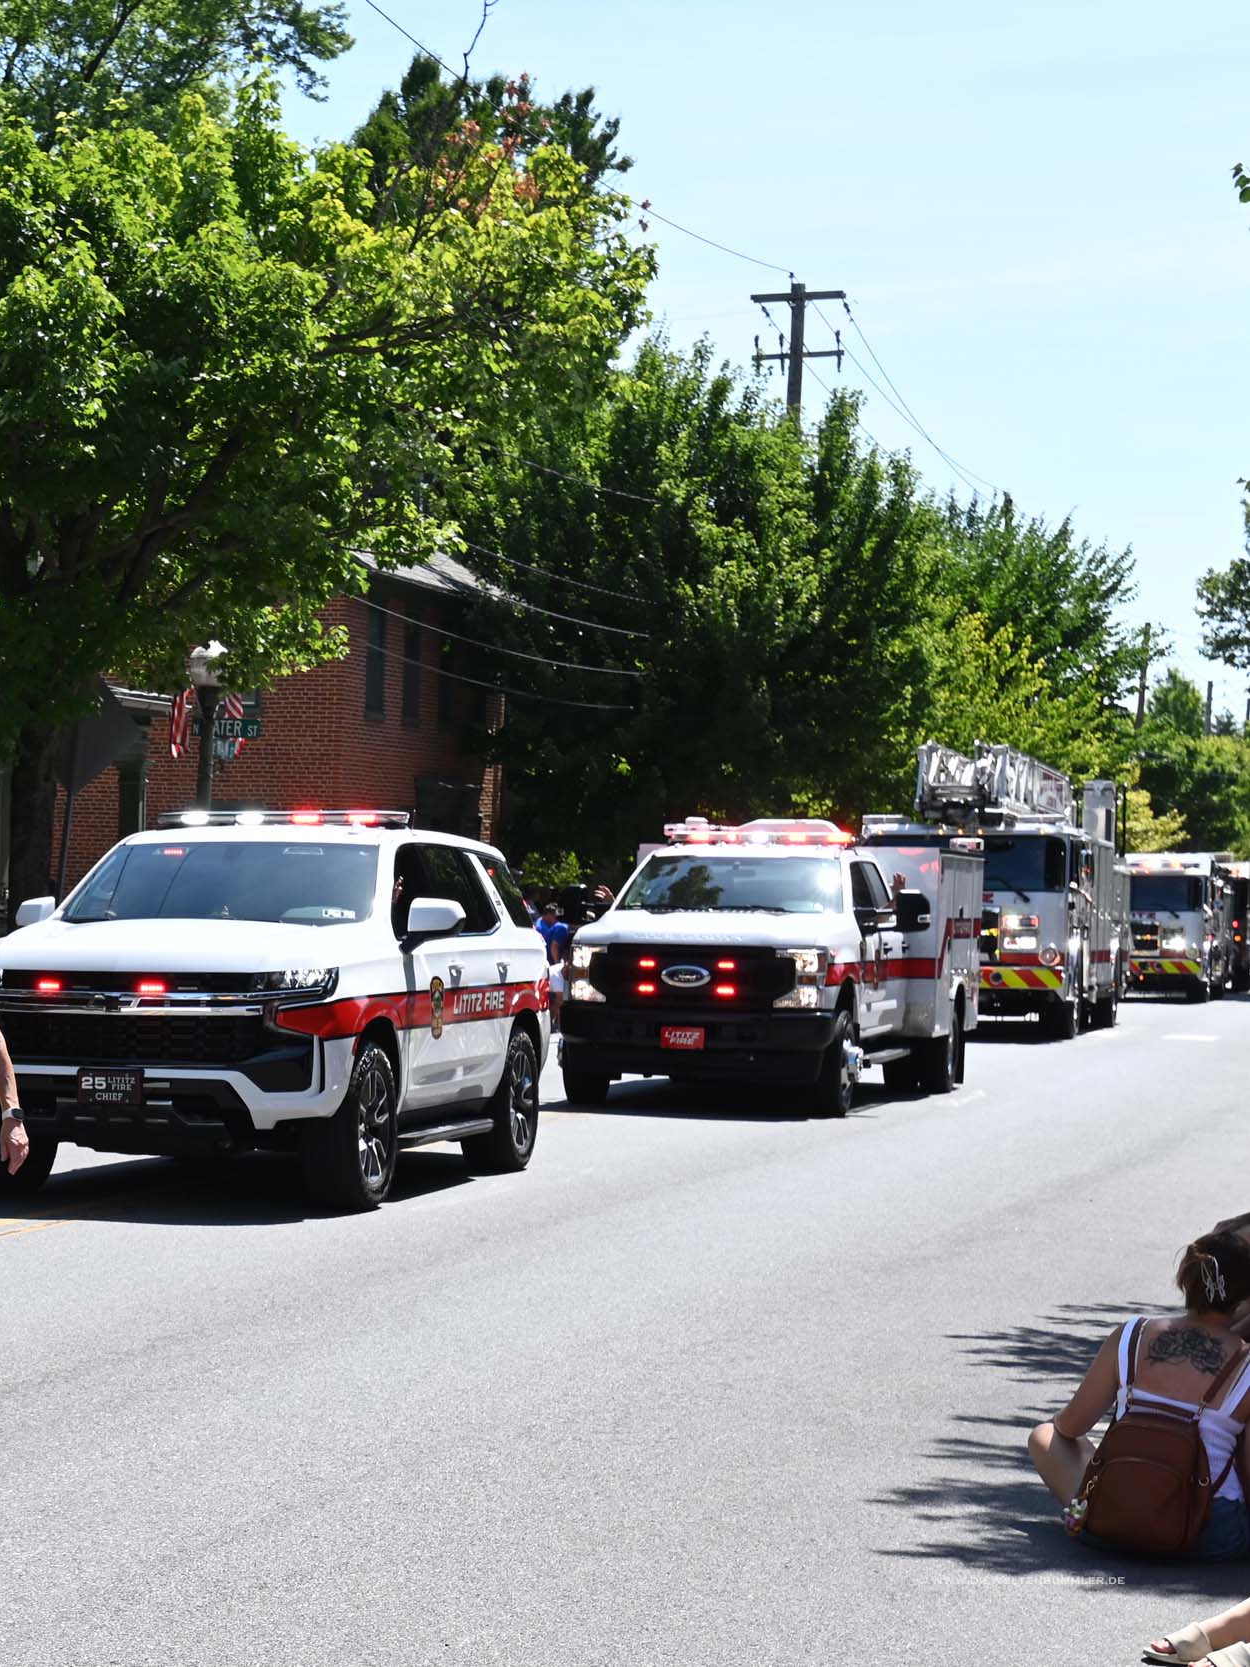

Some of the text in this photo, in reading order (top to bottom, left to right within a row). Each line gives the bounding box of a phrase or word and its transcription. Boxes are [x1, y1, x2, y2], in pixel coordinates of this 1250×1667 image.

[212, 720, 242, 736] ATER
[247, 725, 258, 736] ST
[453, 990, 505, 1015] LITITZ FIRE
[665, 1031, 700, 1039] LITITZ
[81, 1076, 107, 1090] 25
[107, 1076, 136, 1084] LITITZ
[111, 1083, 132, 1091] FIRE
[95, 1092, 123, 1101] CHIEF
